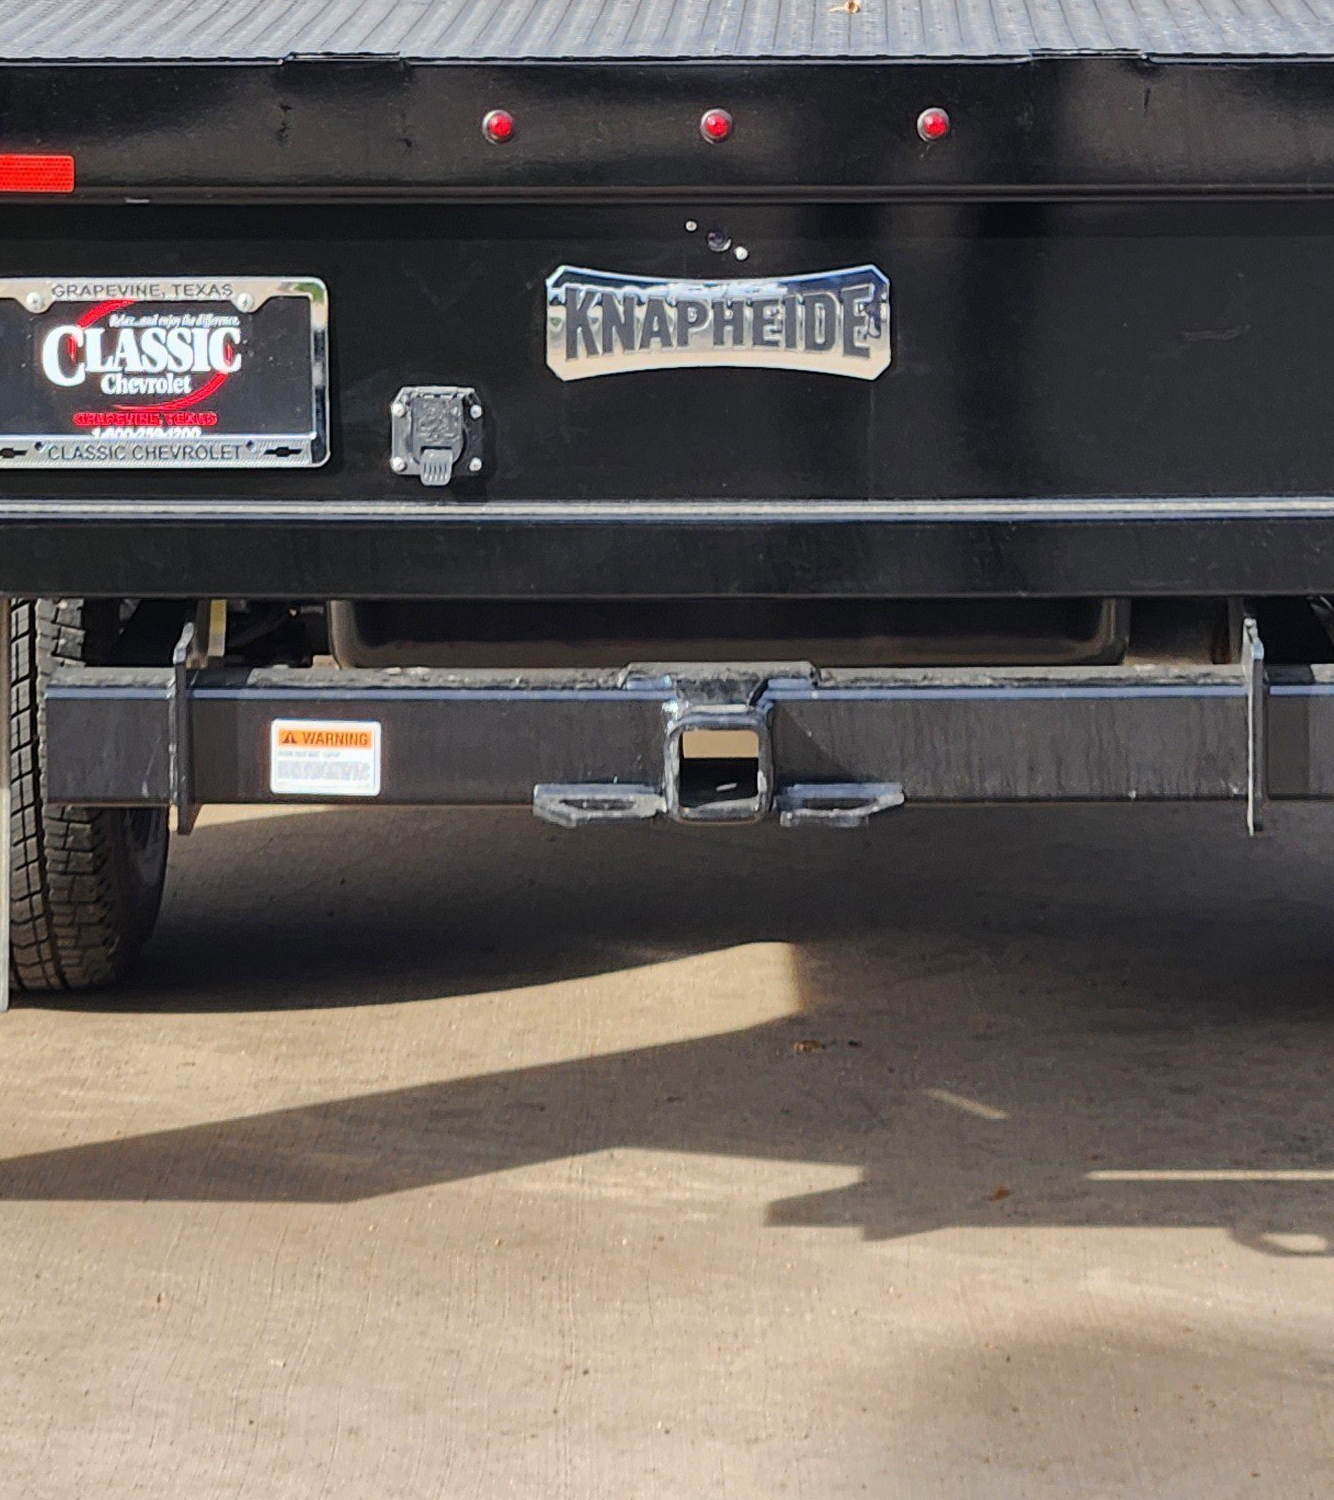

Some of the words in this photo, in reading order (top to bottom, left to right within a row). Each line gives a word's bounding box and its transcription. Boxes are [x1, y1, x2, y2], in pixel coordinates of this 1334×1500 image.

[51, 283, 166, 299] GRAPEVINE,
[174, 283, 234, 297] TEXAS
[565, 283, 874, 361] KNAPHEIDE
[41, 324, 241, 386] CLASSIC
[100, 373, 192, 395] Chevrolet
[48, 445, 126, 461] CLASSIC
[132, 445, 241, 461] CHEVROLET
[302, 731, 369, 746] WARNING
